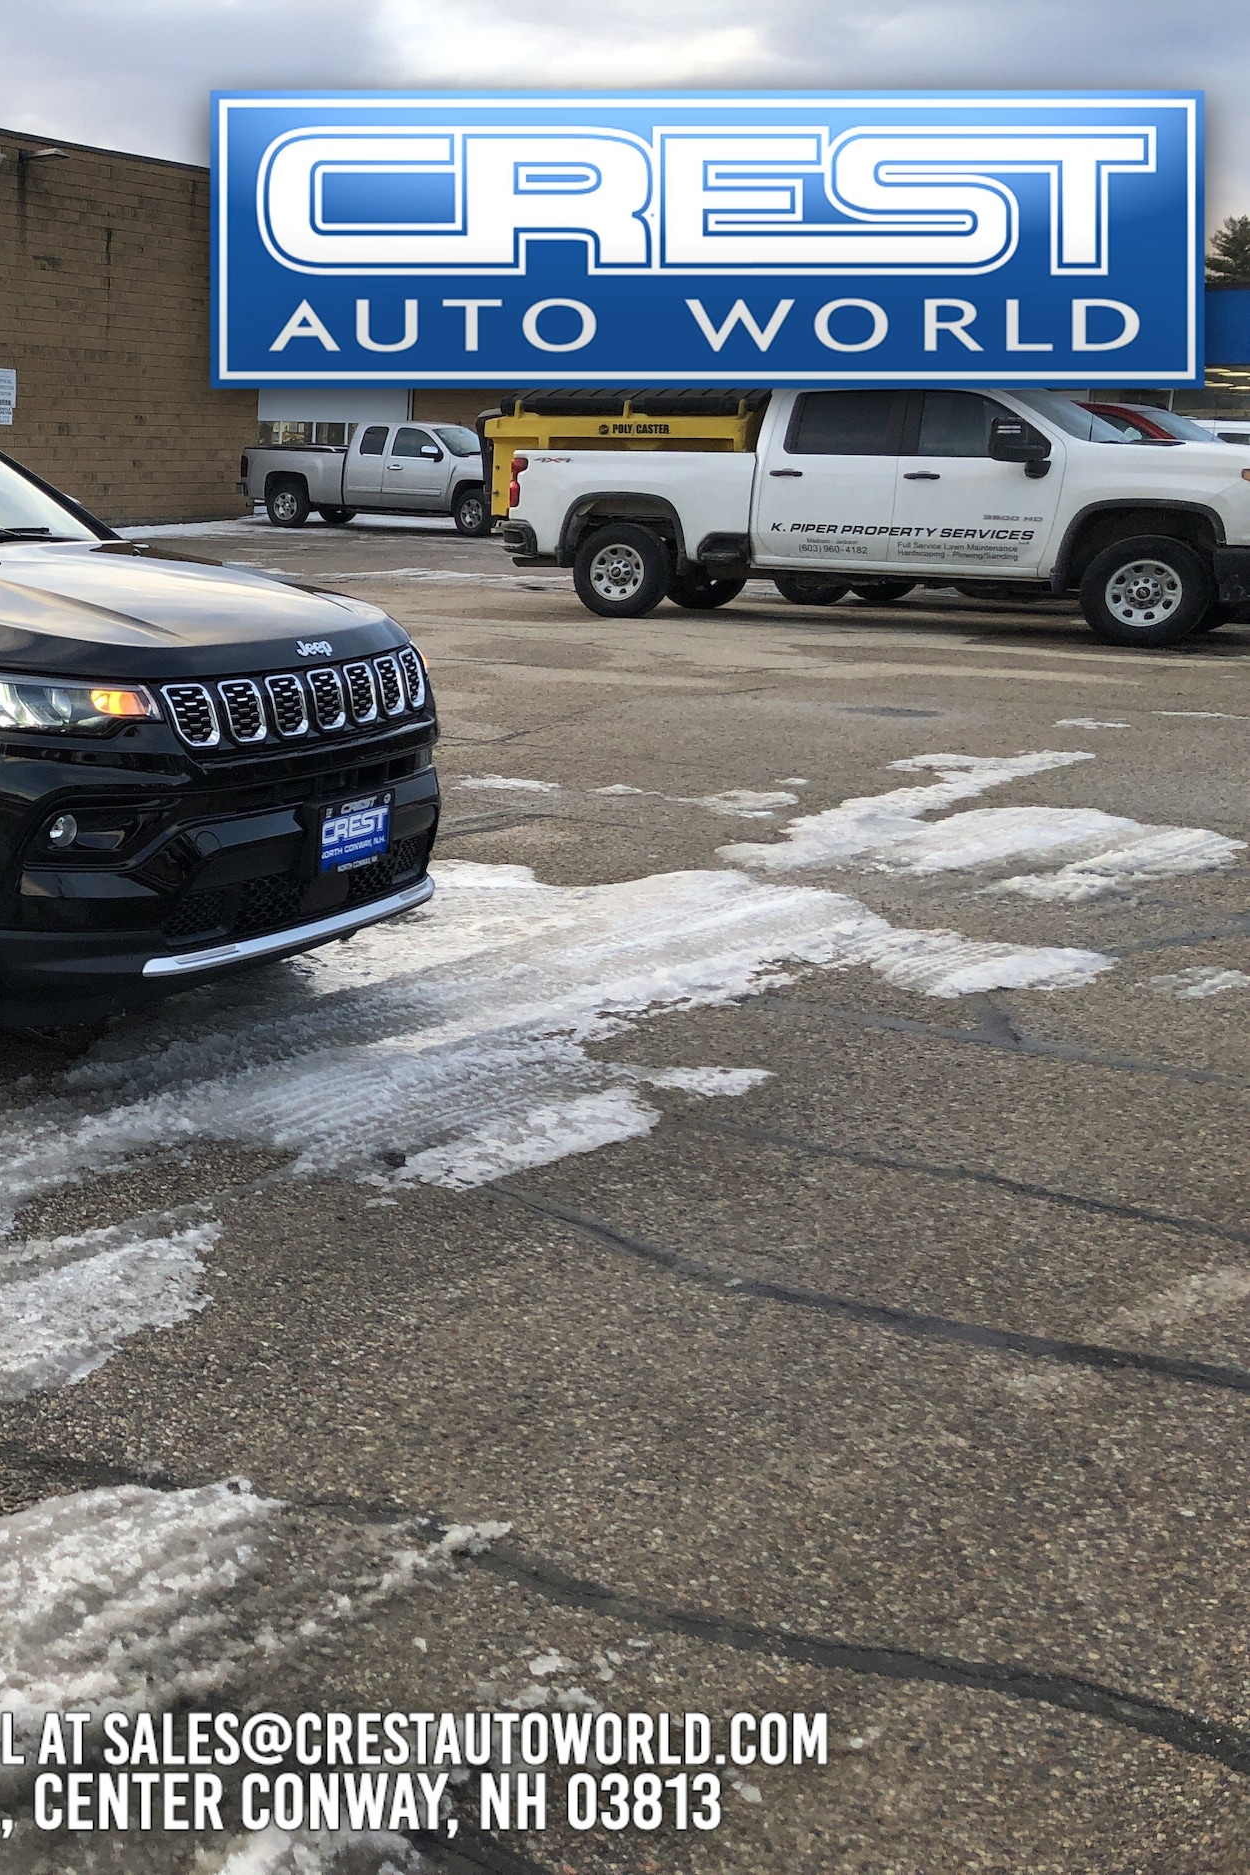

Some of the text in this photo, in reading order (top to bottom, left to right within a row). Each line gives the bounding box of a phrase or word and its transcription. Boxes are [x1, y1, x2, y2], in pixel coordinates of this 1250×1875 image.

[612, 424, 670, 434] POLY CASTER
[771, 522, 1035, 541] K. PIPER PROPERTY SERVICES
[798, 544, 868, 555] (603) 960-4182
[913, 542, 941, 550] Service
[967, 543, 1018, 552] Maintenance
[897, 549, 945, 559] Hardscaping
[296, 640, 333, 656] Jeep
[321, 807, 389, 846] CREST
